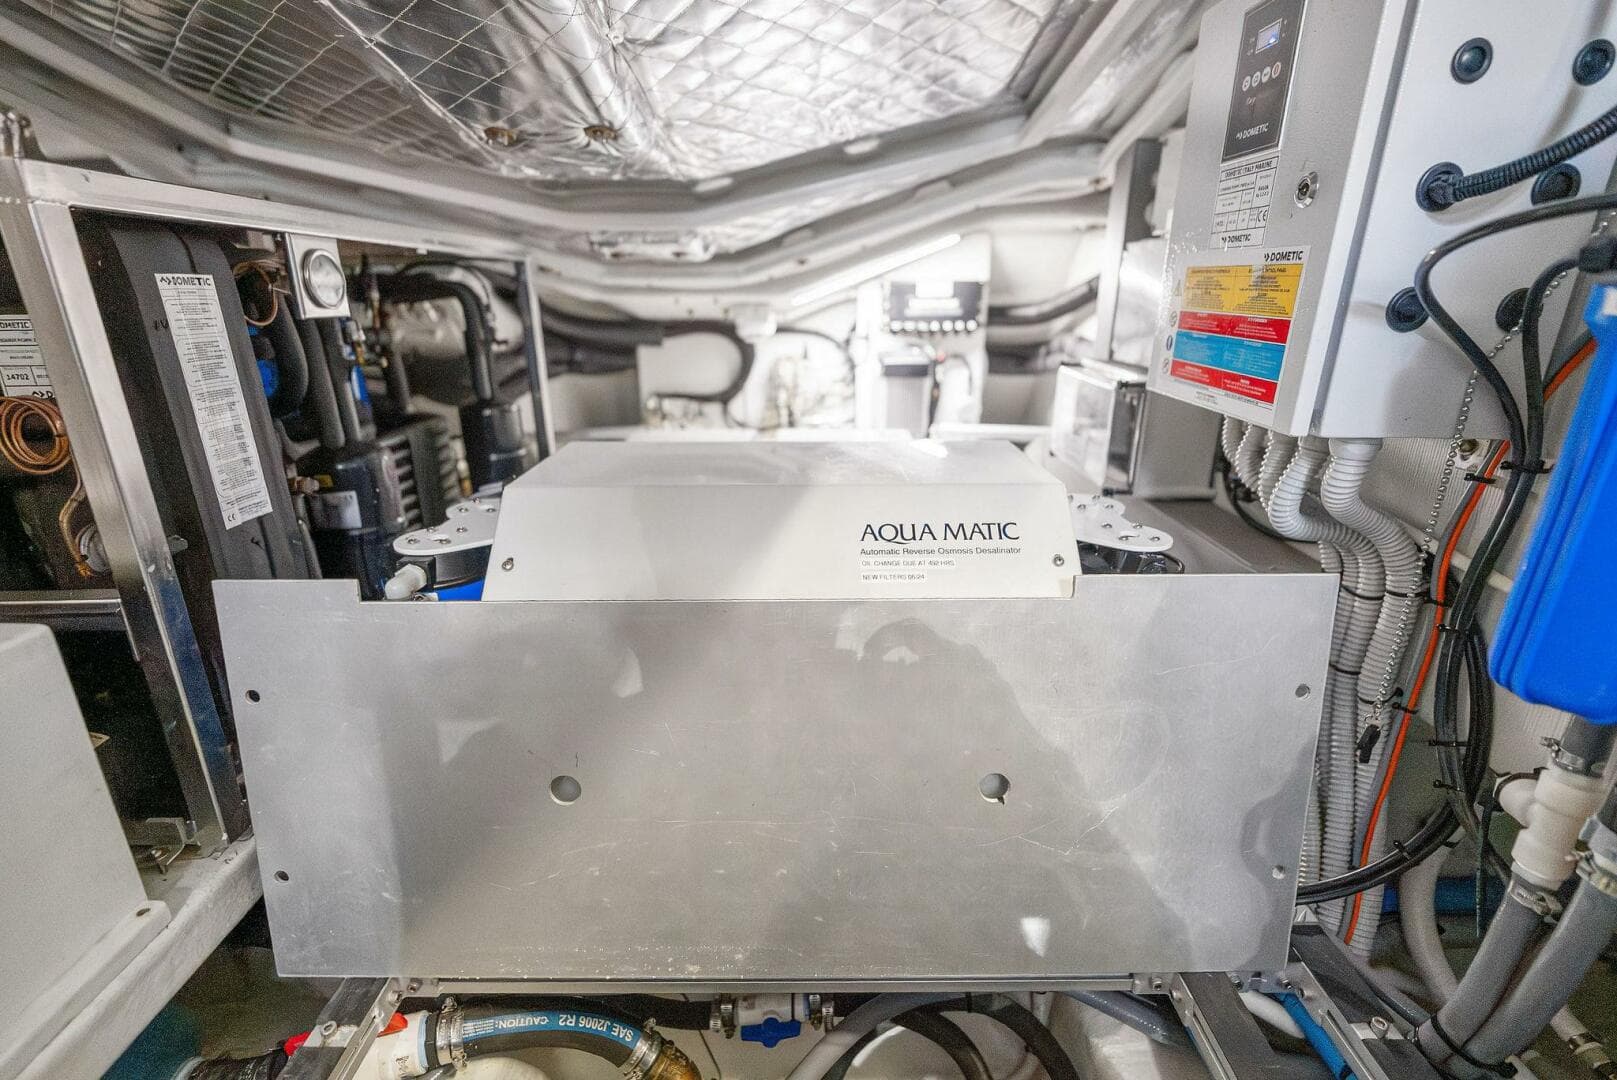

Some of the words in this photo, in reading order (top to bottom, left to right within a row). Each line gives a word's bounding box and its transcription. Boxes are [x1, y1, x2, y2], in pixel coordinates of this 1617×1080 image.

[1270, 250, 1304, 262] DOMETIC
[860, 523, 938, 545] AQUA
[942, 522, 1020, 541] MATIC
[860, 548, 901, 556] Automatic
[902, 548, 936, 556] Reverse
[937, 547, 974, 555] Osmosis
[975, 547, 1022, 555] Desalinator
[494, 1014, 550, 1029] CAUTION:
[558, 1013, 576, 1027] R2
[578, 1016, 611, 1032] J2006
[610, 1023, 635, 1042] SAE
